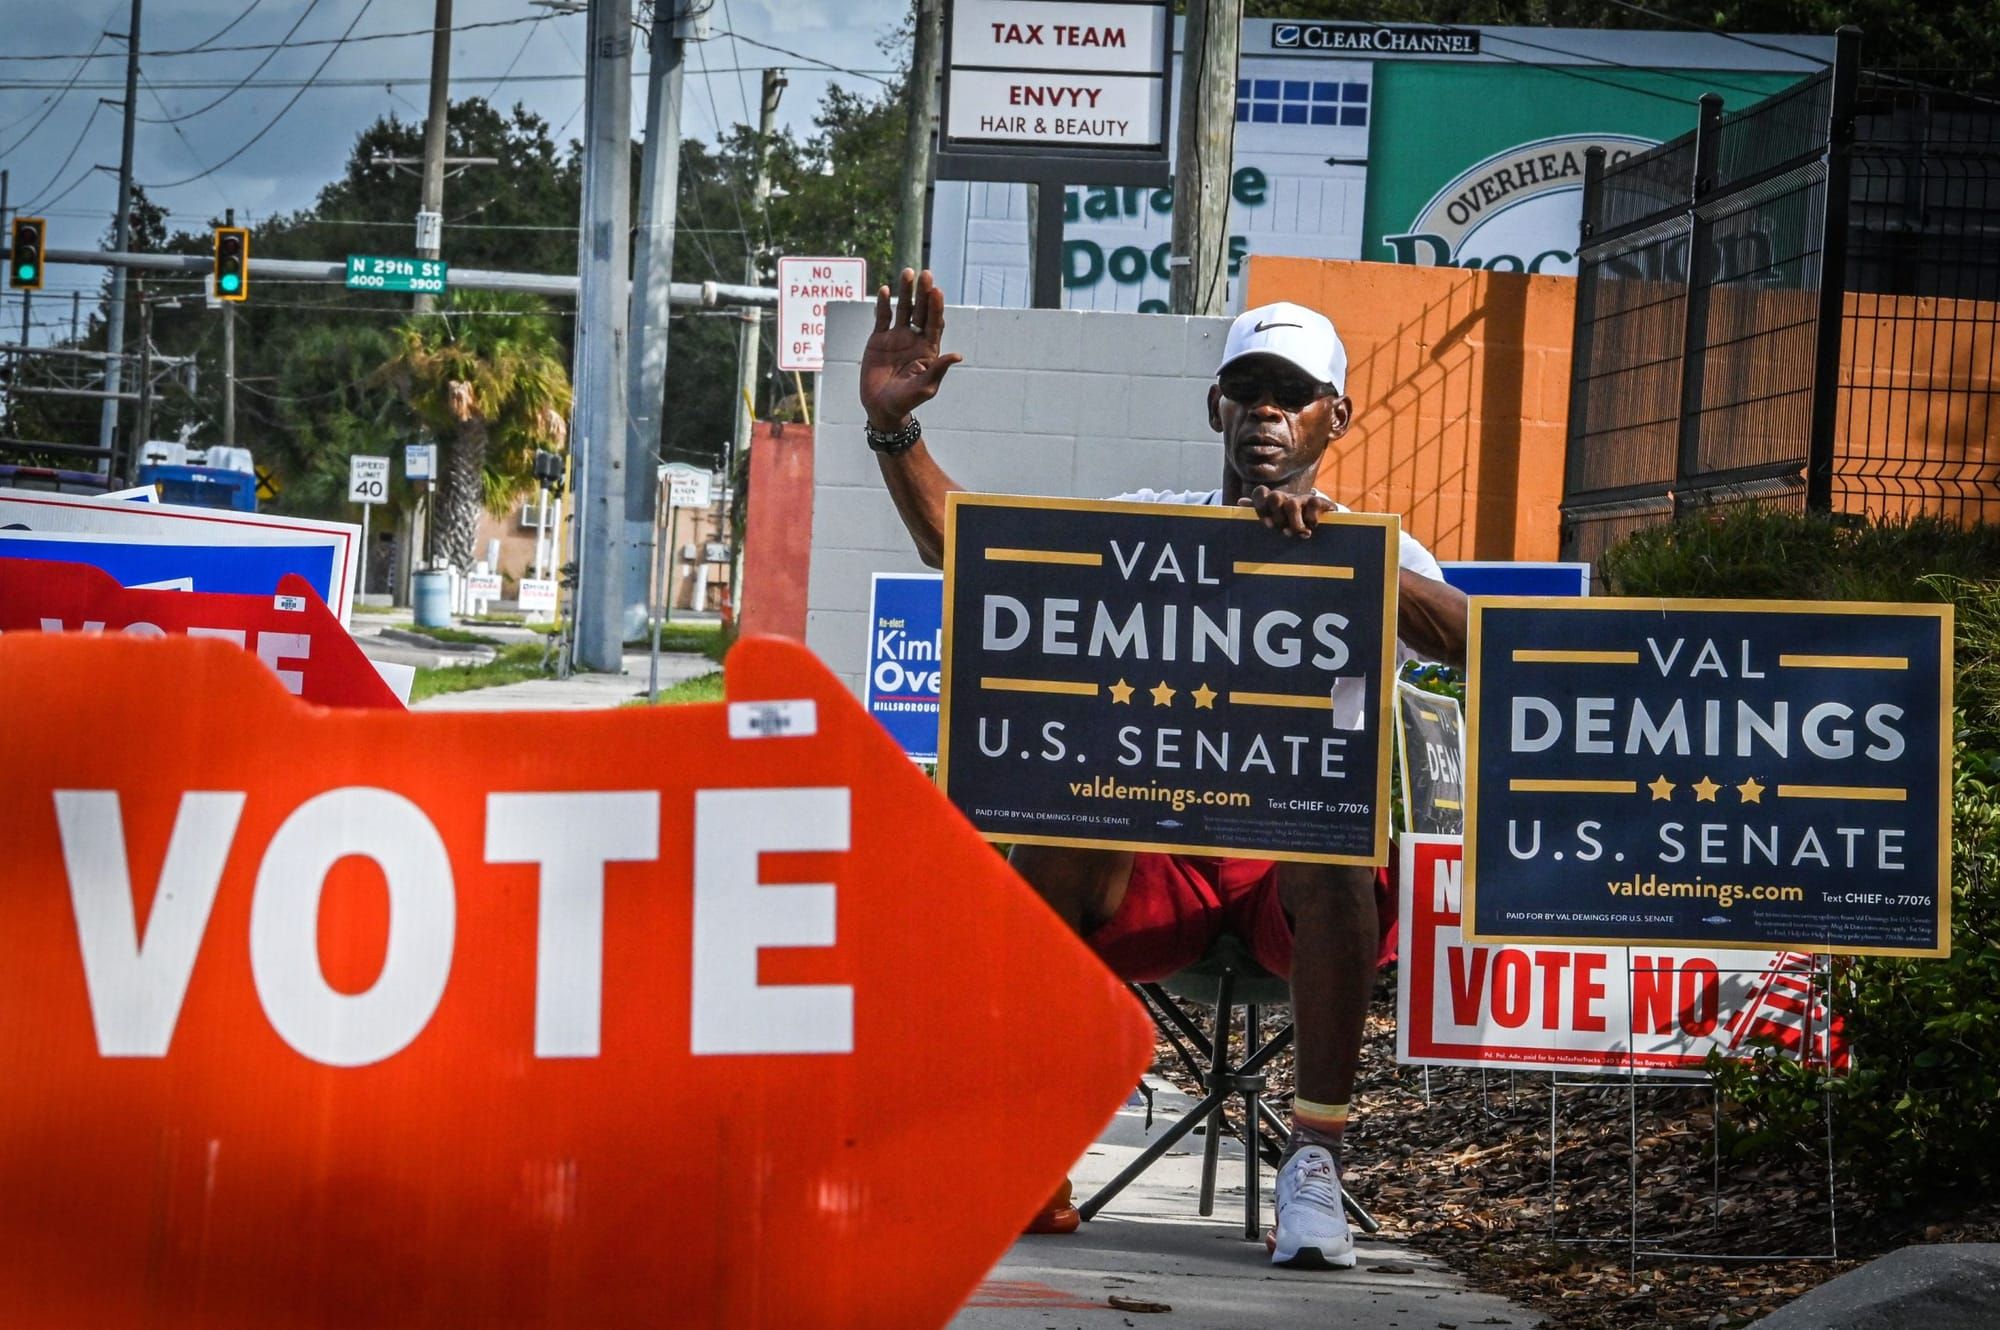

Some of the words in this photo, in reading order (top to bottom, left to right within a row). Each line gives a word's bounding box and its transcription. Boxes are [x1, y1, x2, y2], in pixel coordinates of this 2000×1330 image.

[991, 22, 1044, 45] TAX
[1053, 25, 1126, 48] TEAM
[1009, 85, 1103, 108] ENVYY
[980, 115, 1026, 134] HAIR
[1033, 118, 1048, 134] &
[1055, 118, 1129, 137] BEAUTY
[1446, 150, 1588, 226] OVERHEA
[353, 258, 366, 273] N
[373, 260, 414, 276] 29th
[421, 262, 441, 277] St
[812, 266, 832, 279] NO
[349, 275, 385, 287] 4000
[409, 278, 442, 290] 3900
[790, 284, 854, 298] PARKING
[793, 341, 812, 354] OF
[356, 461, 385, 470] SPEED
[357, 471, 381, 479] LIMIT
[355, 480, 383, 497] 40
[1109, 539, 1220, 585] VAL
[878, 617, 905, 628] Re-elect
[982, 593, 1350, 671] DEMINGS
[1646, 637, 1765, 679] VAL
[1510, 696, 1906, 762] DEMINGS
[978, 716, 1086, 764] U.S.
[1117, 725, 1348, 779] SENATE
[1068, 776, 1251, 812] valdemings.com
[1267, 798, 1287, 809] Text
[1289, 799, 1324, 811] CHIEF
[1325, 803, 1336, 813] to
[1337, 802, 1370, 814] 77076
[975, 808, 993, 817] PAID
[994, 809, 1010, 817] FOR
[1011, 810, 1021, 818] BY
[1021, 811, 1035, 819] VAL
[1036, 812, 1071, 822] DEMINGS
[1072, 814, 1088, 823] FOR
[1088, 815, 1101, 824] U.S.
[1103, 816, 1130, 826] SENATE
[1508, 819, 1625, 862] U.S.
[1658, 822, 1906, 870] SENATE
[1607, 873, 1804, 907] valdemings.com
[1821, 891, 1842, 903] Text
[1845, 892, 1882, 904] CHIEF
[1884, 896, 1895, 905] to
[1897, 894, 1931, 906] 77076
[52, 785, 855, 1067] VOTE
[1506, 912, 1525, 920] PAID
[1526, 912, 1543, 920] FOR
[1544, 912, 1555, 921] BY
[1555, 913, 1571, 921] VAL
[1572, 913, 1610, 922] DEMINGS
[1610, 914, 1628, 922] FOR
[1630, 914, 1642, 922] U.S.
[1644, 915, 1674, 923] SENATE
[1447, 946, 1607, 1032] VOTE
[1632, 955, 1720, 1038] NO
[1548, 1054, 1555, 1062] by
